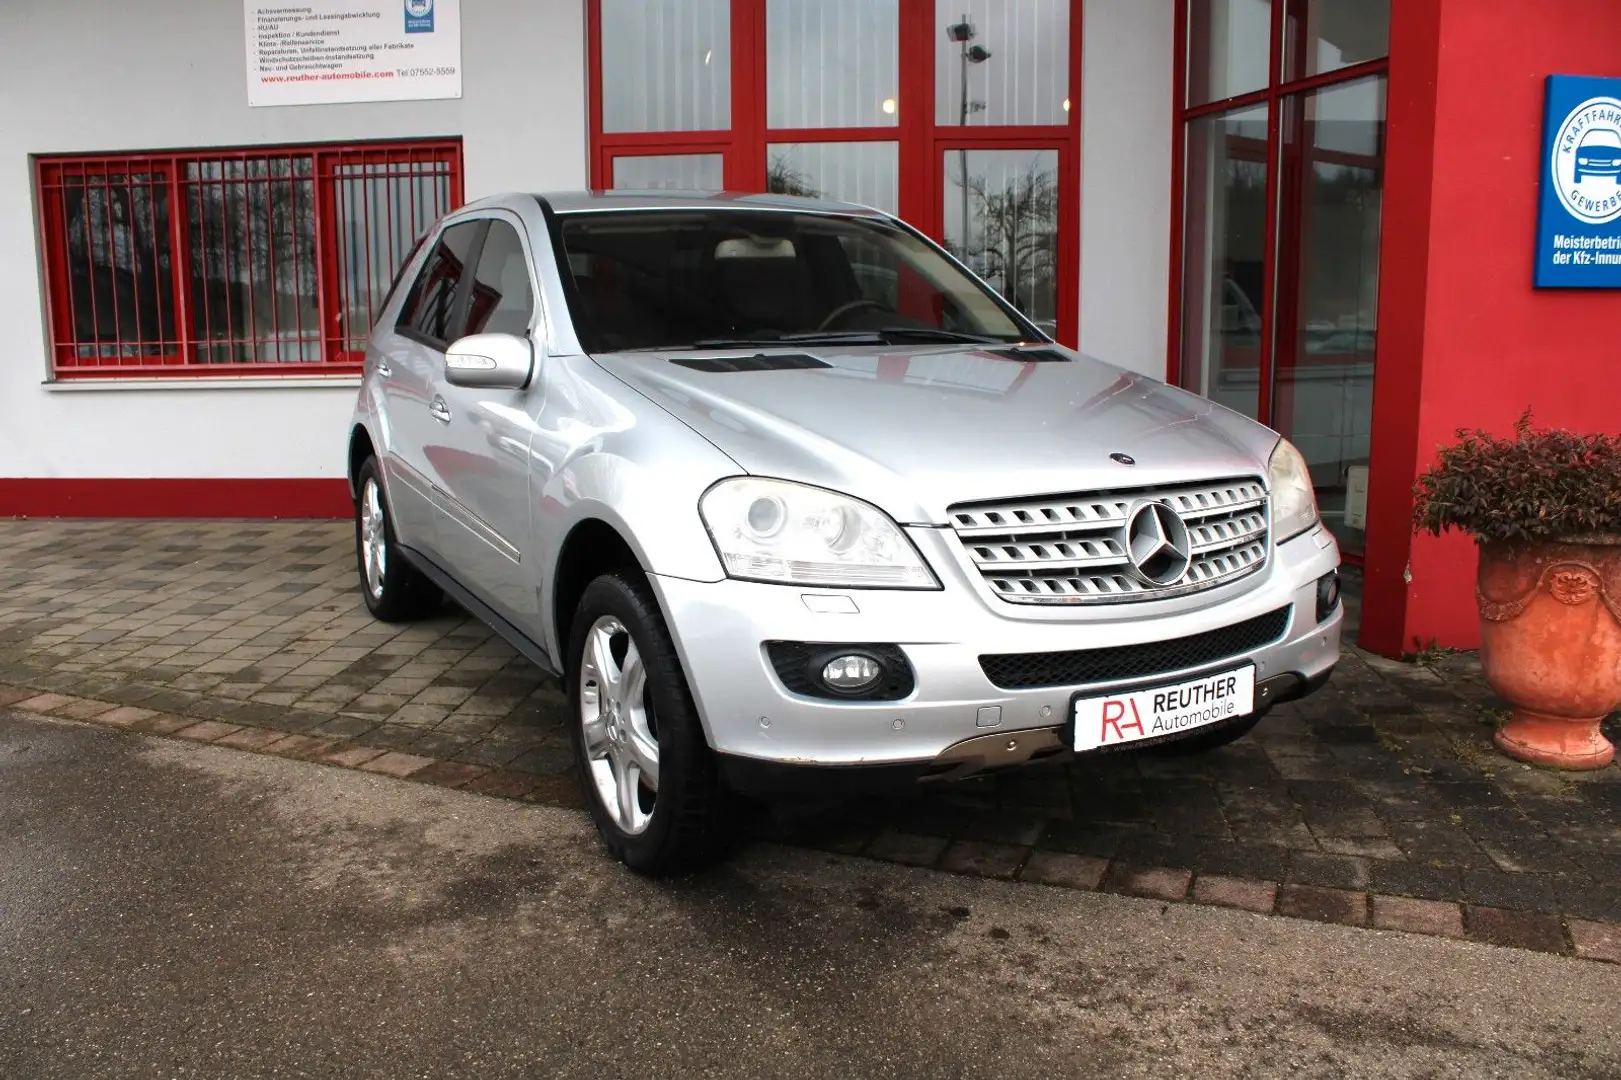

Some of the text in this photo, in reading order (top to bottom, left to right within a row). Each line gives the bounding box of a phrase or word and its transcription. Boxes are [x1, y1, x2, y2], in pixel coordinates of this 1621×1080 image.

[257, 7, 312, 15] Achsvermessung
[257, 15, 304, 23] Finanzierungs-
[258, 32, 291, 40] Inspektion
[261, 70, 394, 83] www.reuther-automobile.com
[1571, 189, 1621, 212] GEWERBE
[1553, 234, 1621, 250] Meisterbetri
[1553, 250, 1572, 265] der
[1153, 676, 1236, 714] REUTHER
[1101, 697, 1145, 742] RA
[1152, 701, 1235, 733] Automobile
